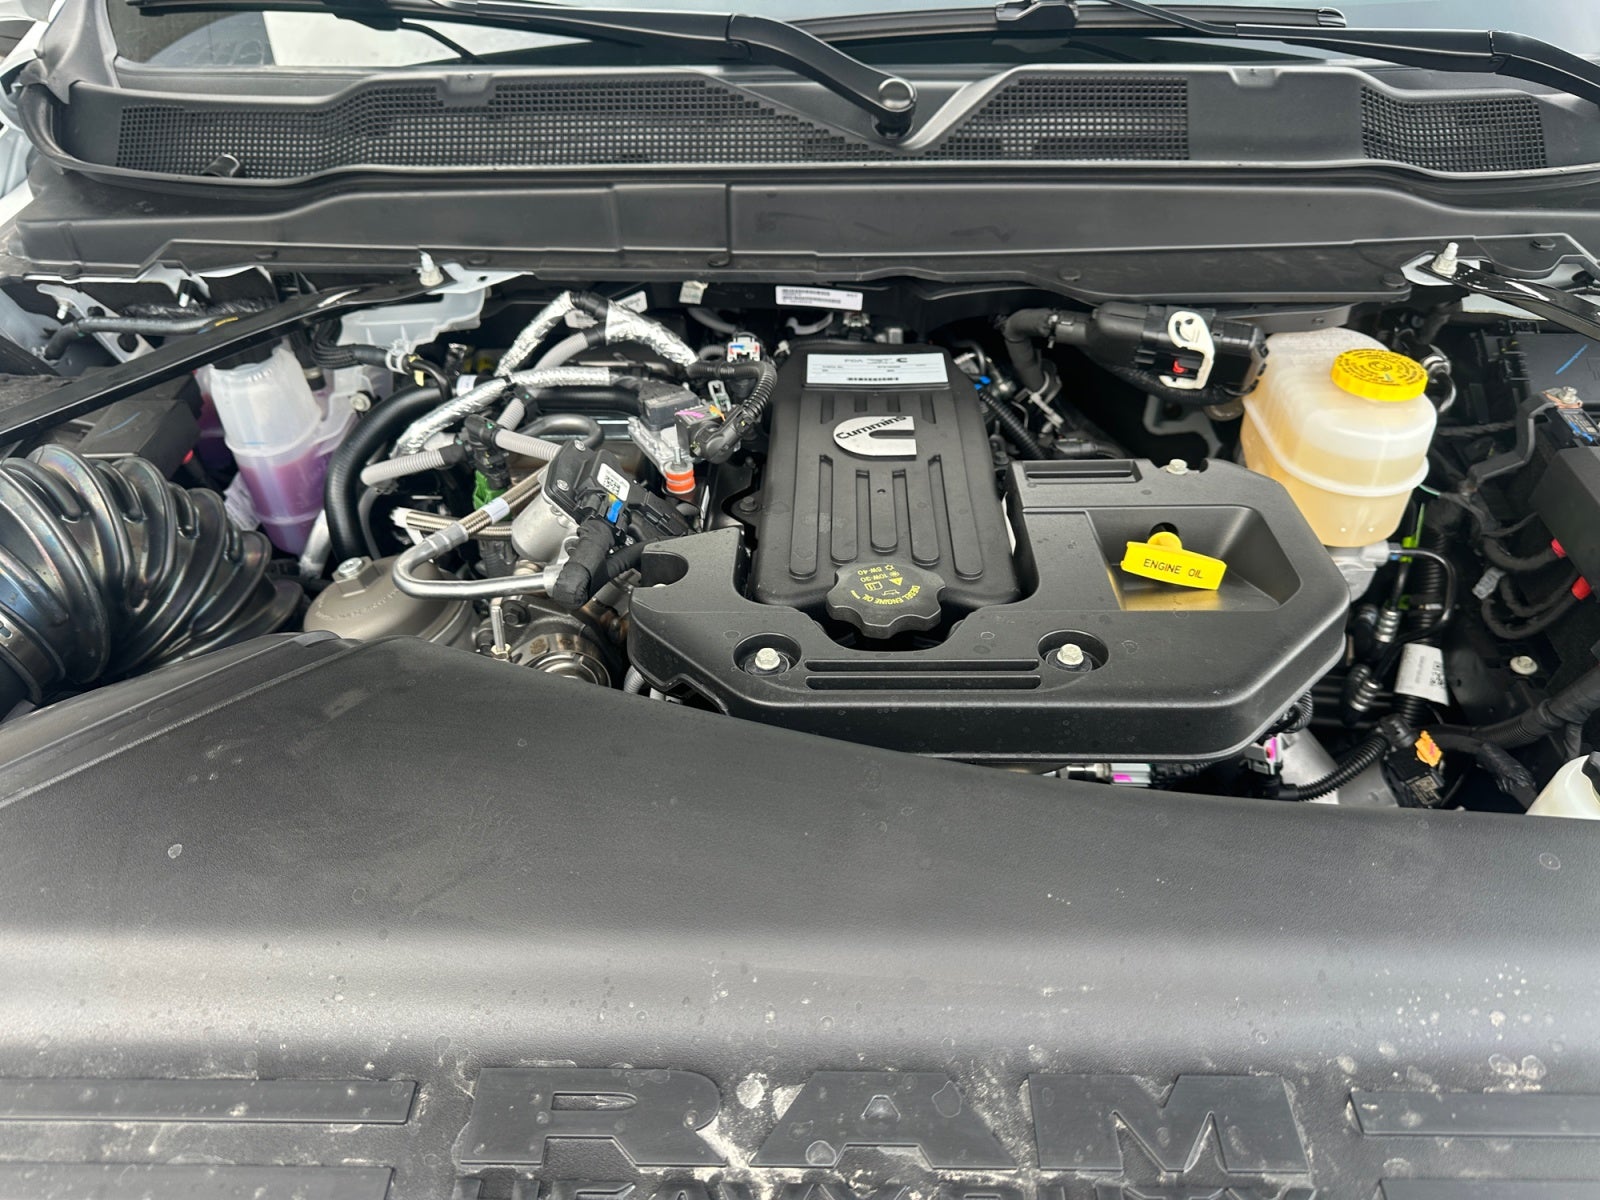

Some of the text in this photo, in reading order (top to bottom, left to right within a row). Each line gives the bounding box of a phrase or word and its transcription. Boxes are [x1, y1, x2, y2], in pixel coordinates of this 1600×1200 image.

[836, 415, 907, 440] Cummins
[858, 567, 882, 575] 5W-40
[1143, 558, 1204, 579] ENGINE OIL
[860, 574, 888, 582] 10W-30
[874, 597, 904, 605] ENGINE
[459, 1065, 1310, 1174] RAM
